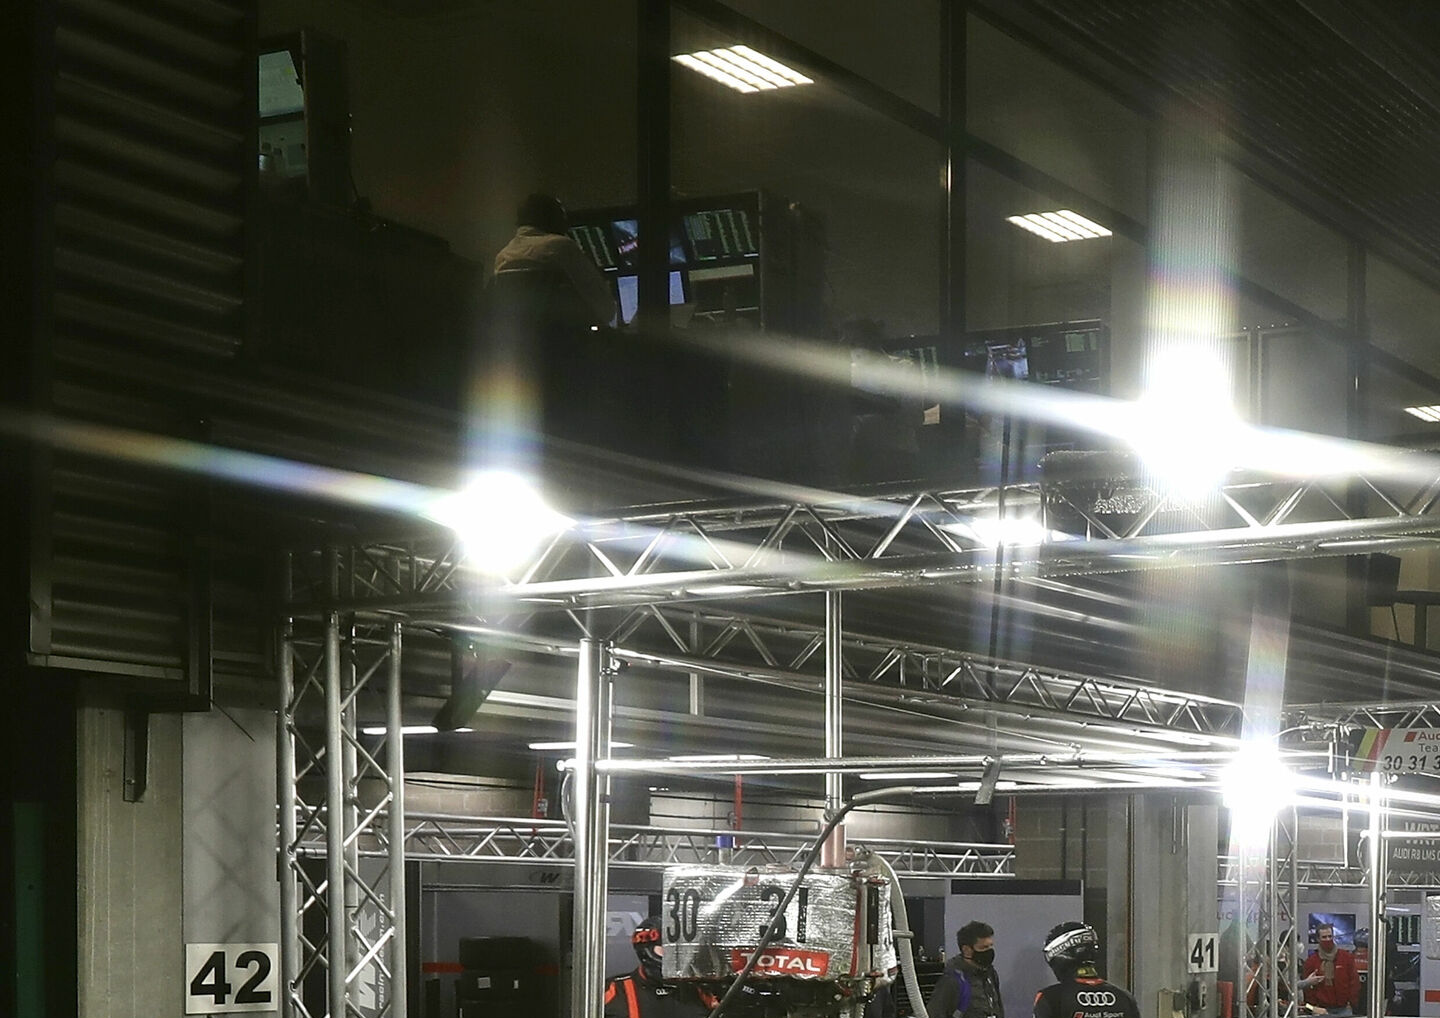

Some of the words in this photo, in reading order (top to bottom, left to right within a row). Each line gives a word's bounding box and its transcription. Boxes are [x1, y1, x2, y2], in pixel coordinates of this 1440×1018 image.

[1383, 755, 1403, 771] 30
[1408, 755, 1426, 771] 31
[666, 887, 699, 943] 30
[760, 886, 808, 943] 31
[739, 951, 821, 972] TOTAL
[1190, 937, 1215, 969] 41
[190, 950, 272, 1005] 42
[1084, 1011, 1101, 1018] Audi
